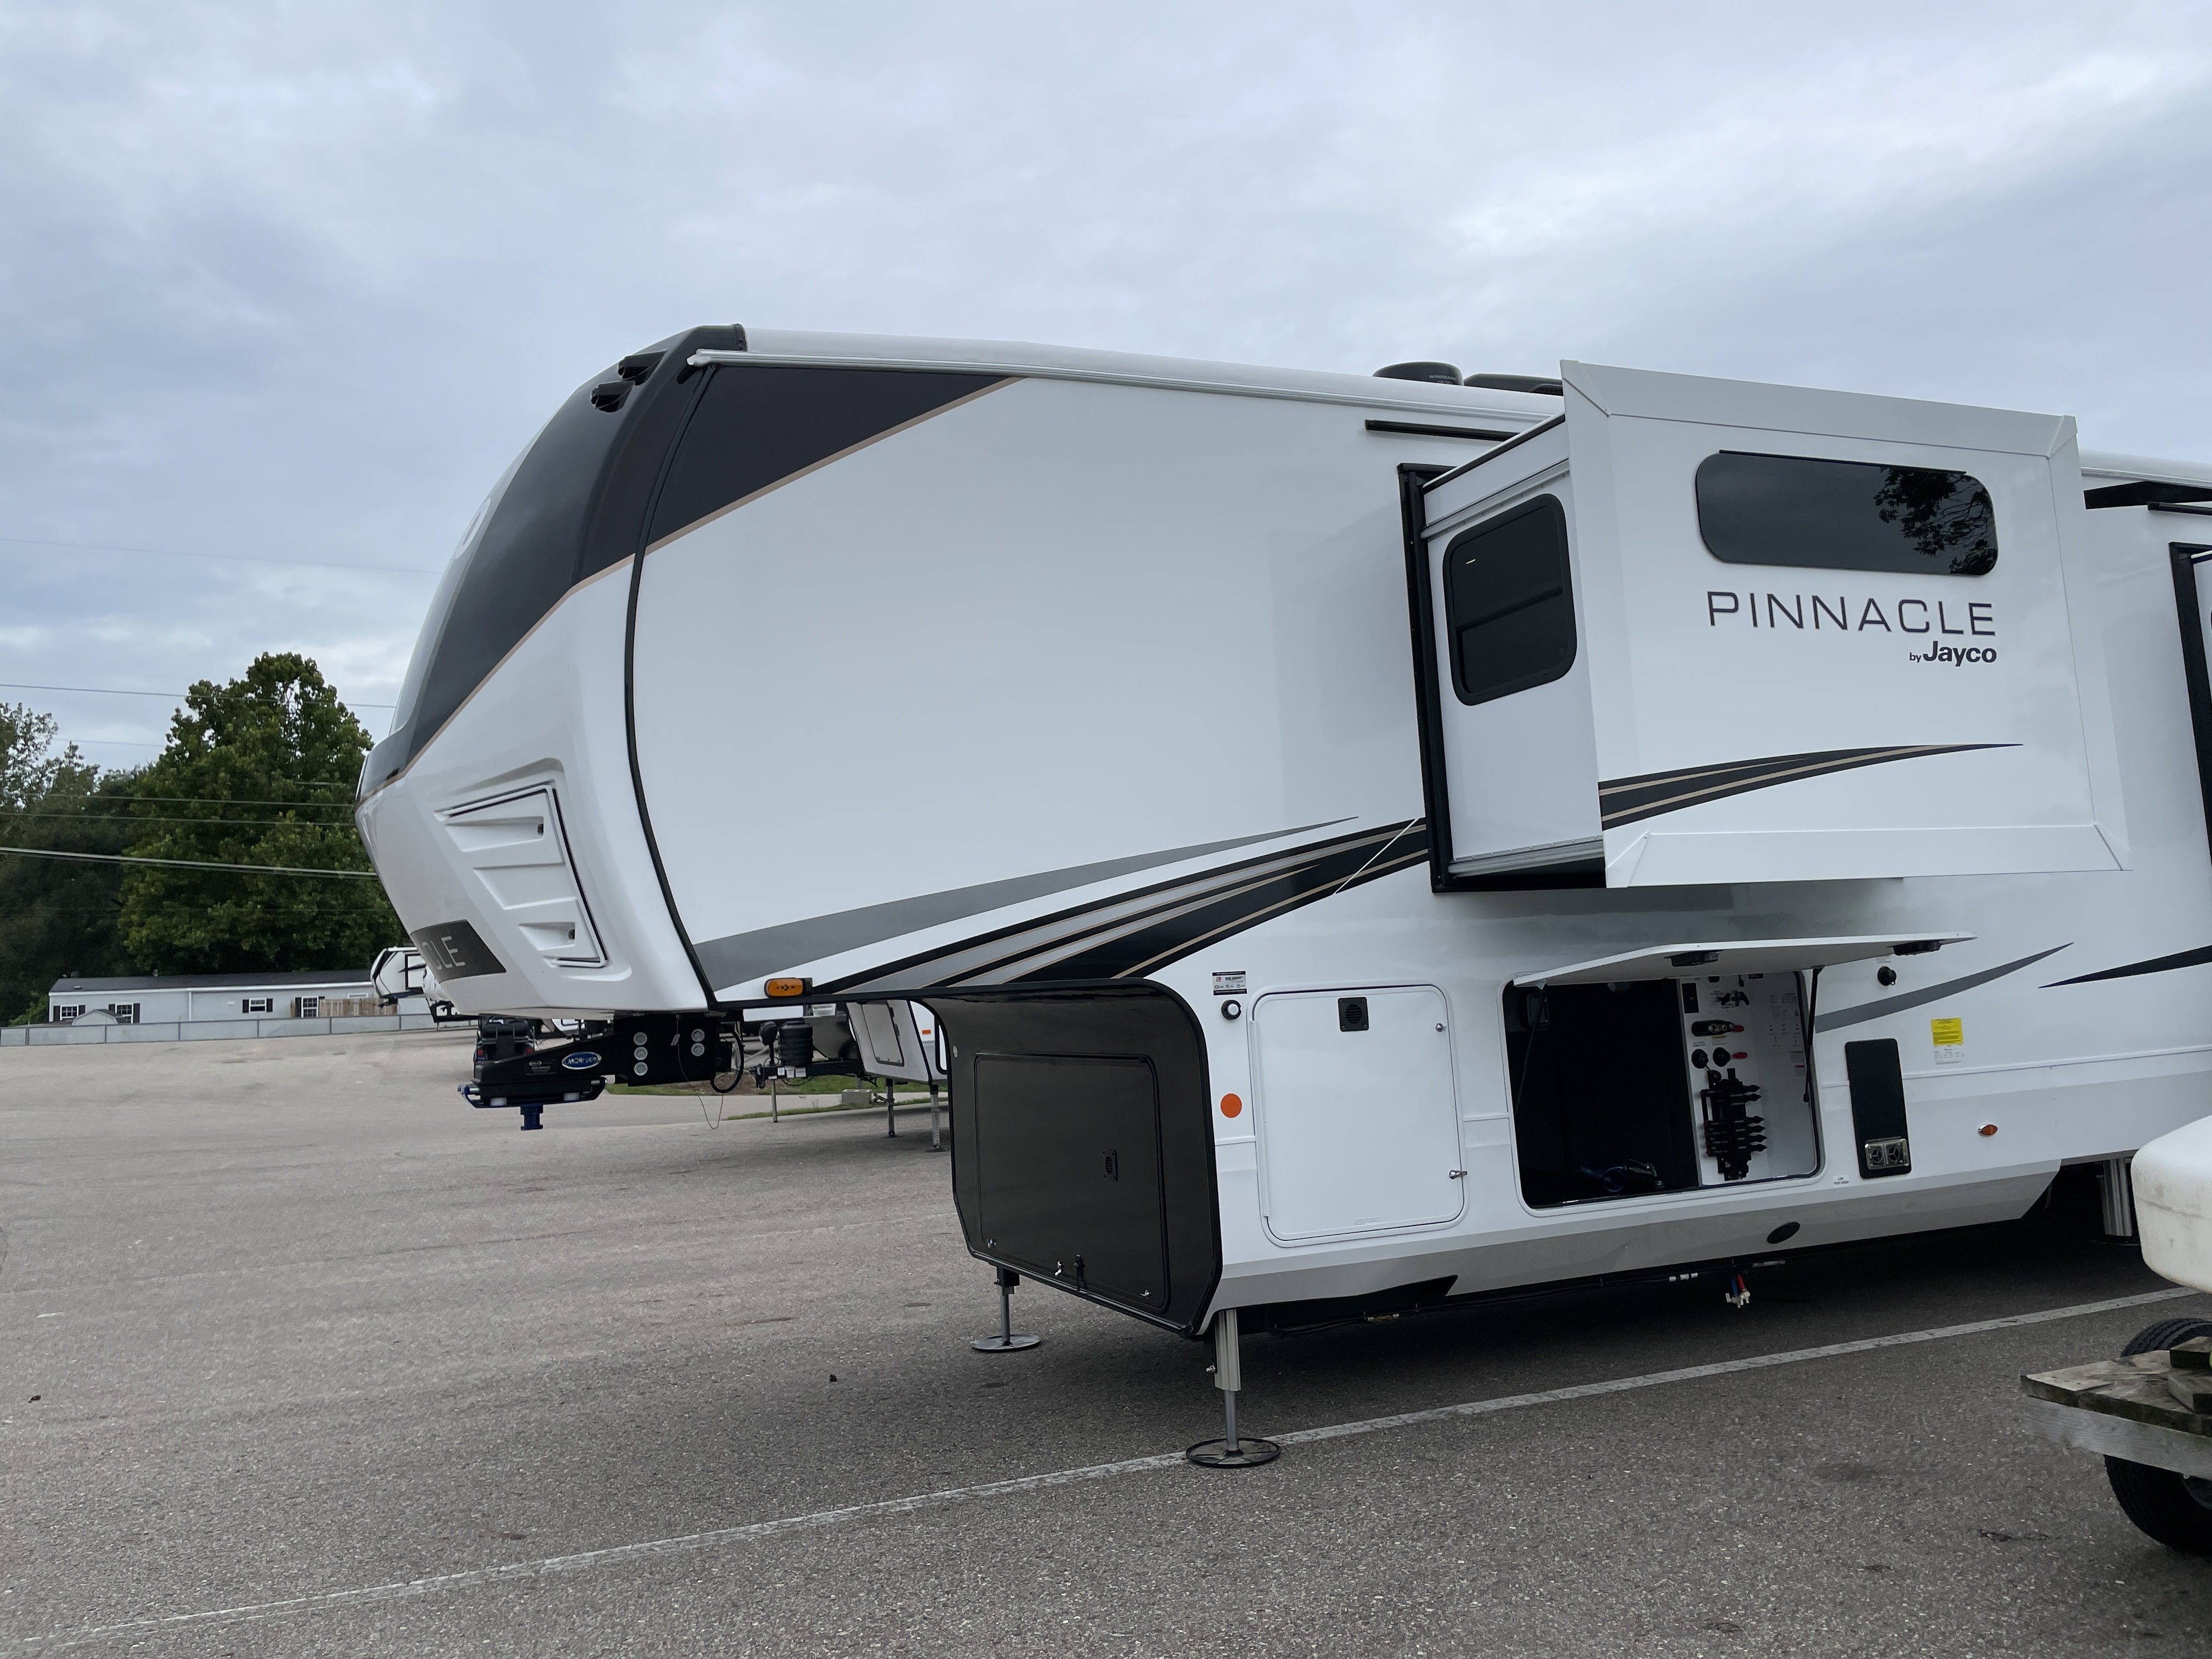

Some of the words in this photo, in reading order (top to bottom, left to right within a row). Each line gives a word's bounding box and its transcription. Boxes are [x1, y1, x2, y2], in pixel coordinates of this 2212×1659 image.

[1707, 591, 1996, 636] PINNACLE
[1909, 652, 1921, 663] by
[1922, 640, 1997, 667] Jayco
